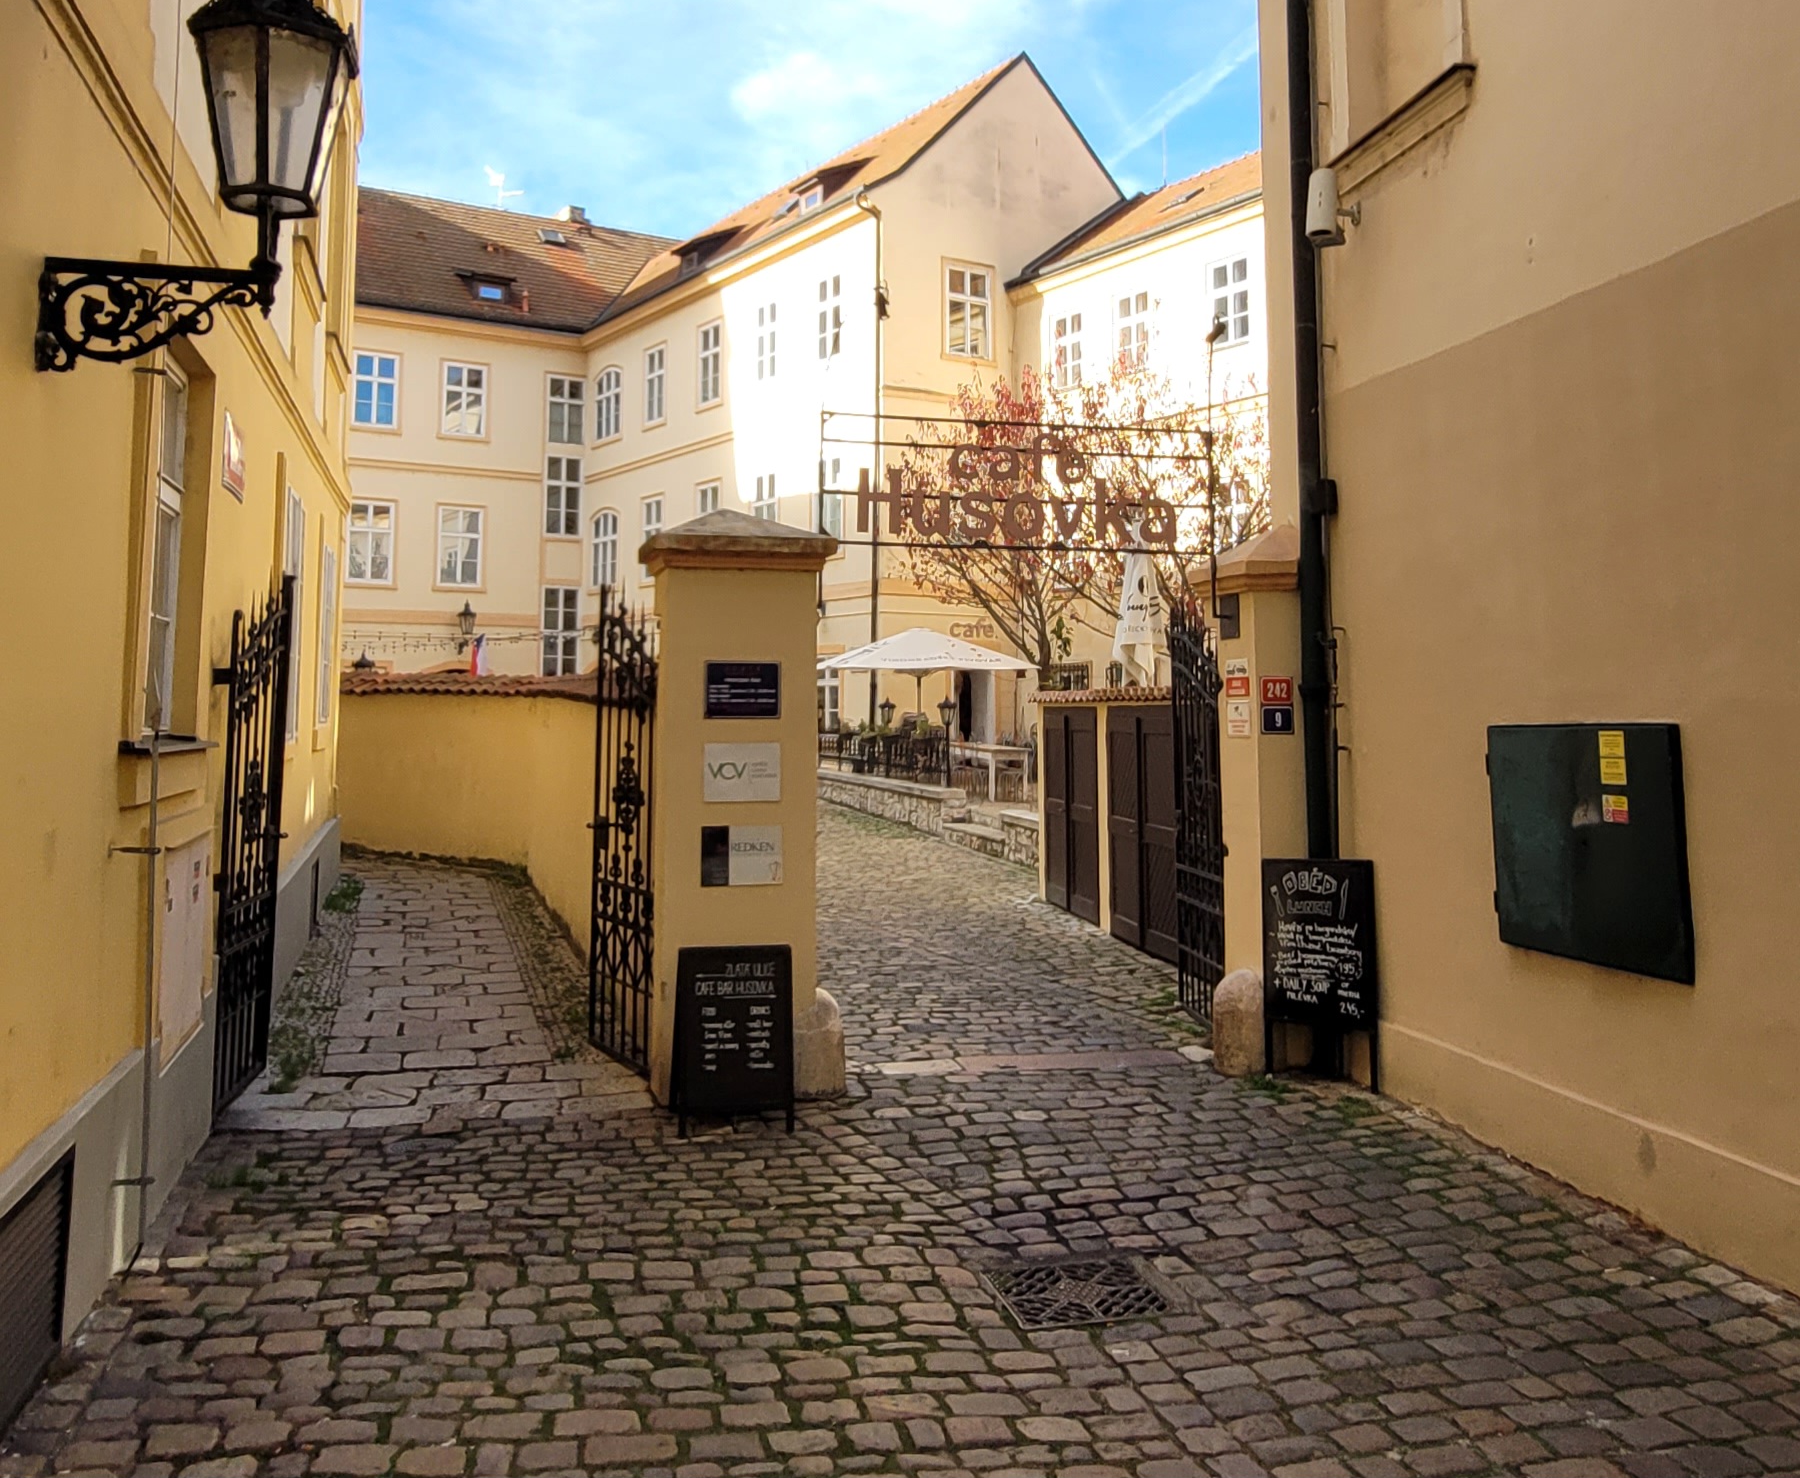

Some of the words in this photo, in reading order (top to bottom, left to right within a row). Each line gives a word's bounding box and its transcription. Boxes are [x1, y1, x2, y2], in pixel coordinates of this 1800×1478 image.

[857, 467, 1177, 544] Husovka
[1267, 682, 1288, 698] 242
[1275, 711, 1283, 728] 9
[708, 762, 748, 780] VCV
[731, 842, 775, 852] REDKEN
[1286, 899, 1333, 917] LUNCH
[717, 980, 734, 996] BAR
[735, 980, 775, 995] HUSOVKA
[1283, 976, 1308, 992] DAILY
[1310, 979, 1330, 995] SOUP
